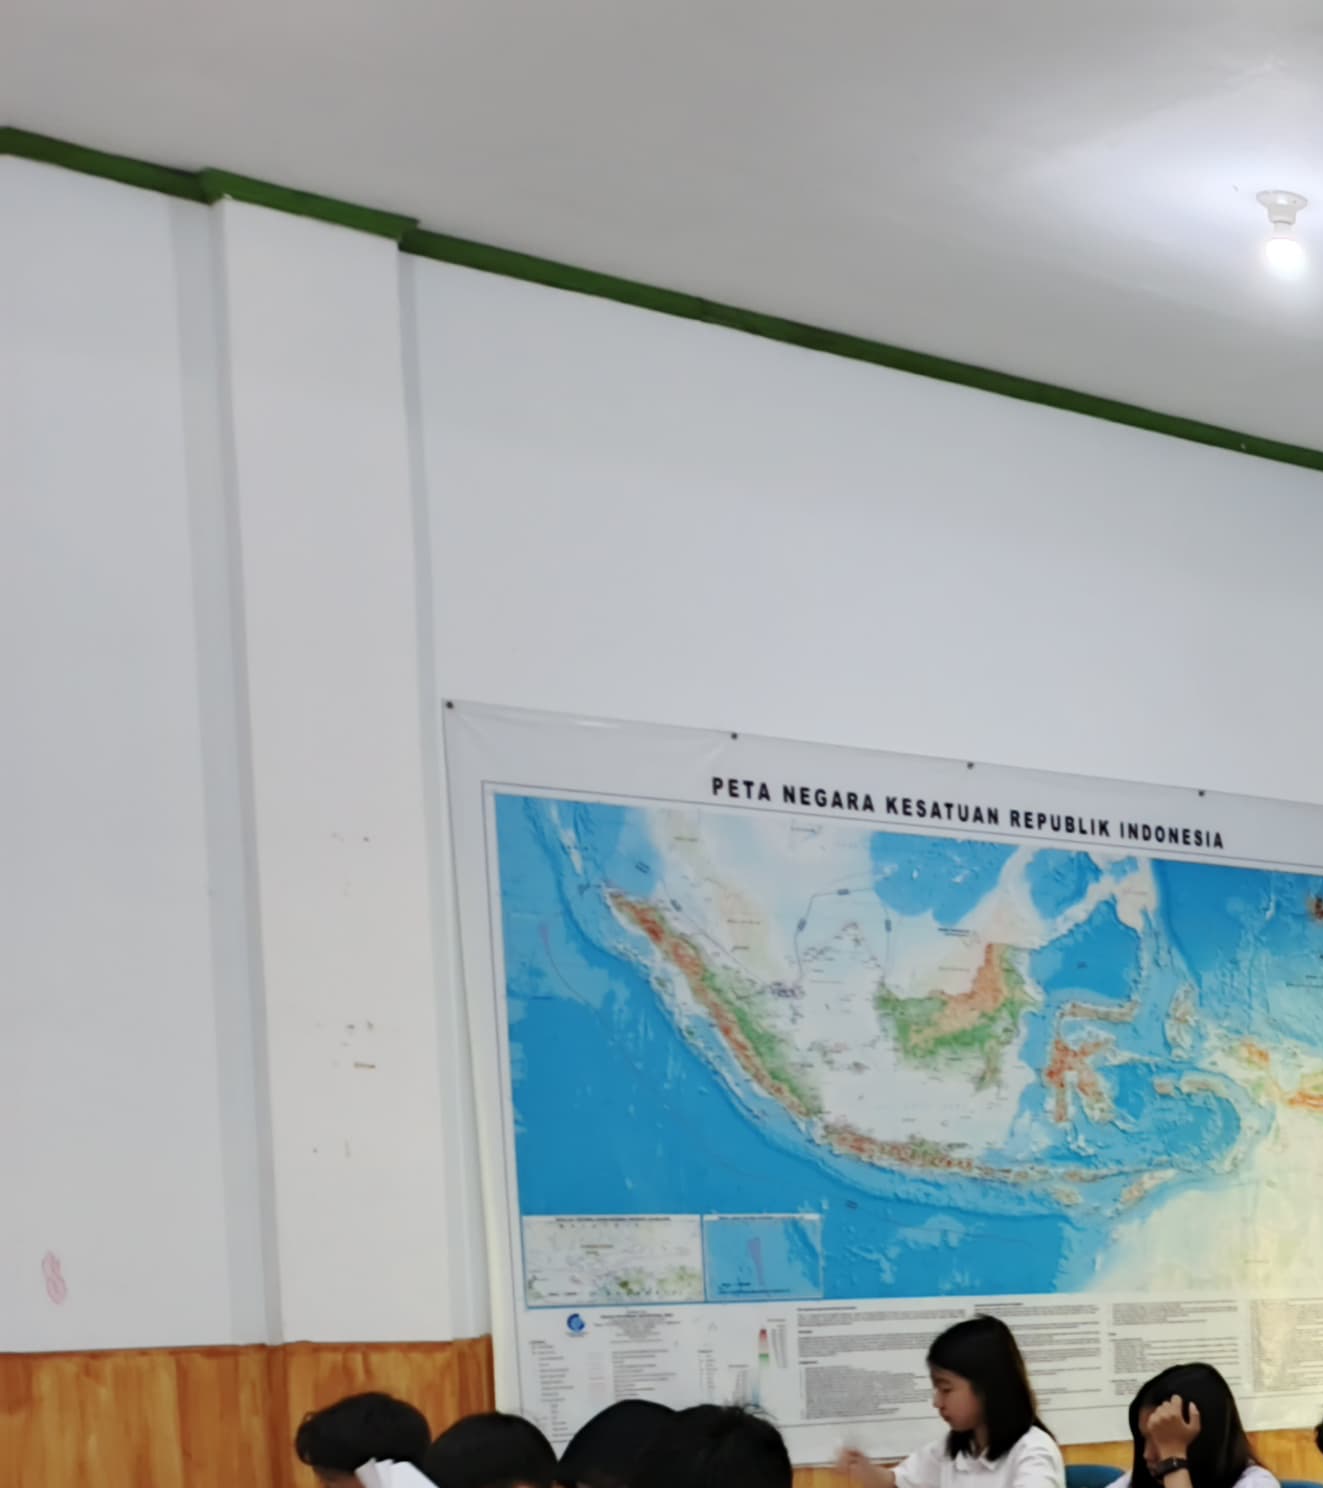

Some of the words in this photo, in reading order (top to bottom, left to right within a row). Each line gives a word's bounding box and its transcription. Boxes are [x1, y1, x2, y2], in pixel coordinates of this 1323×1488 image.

[712, 777, 771, 801] PETA
[783, 784, 875, 812] NEGARA
[886, 796, 999, 825] KESATUAN
[1009, 809, 1110, 837] REPUBLIK
[1119, 821, 1224, 849] INDONESIA
